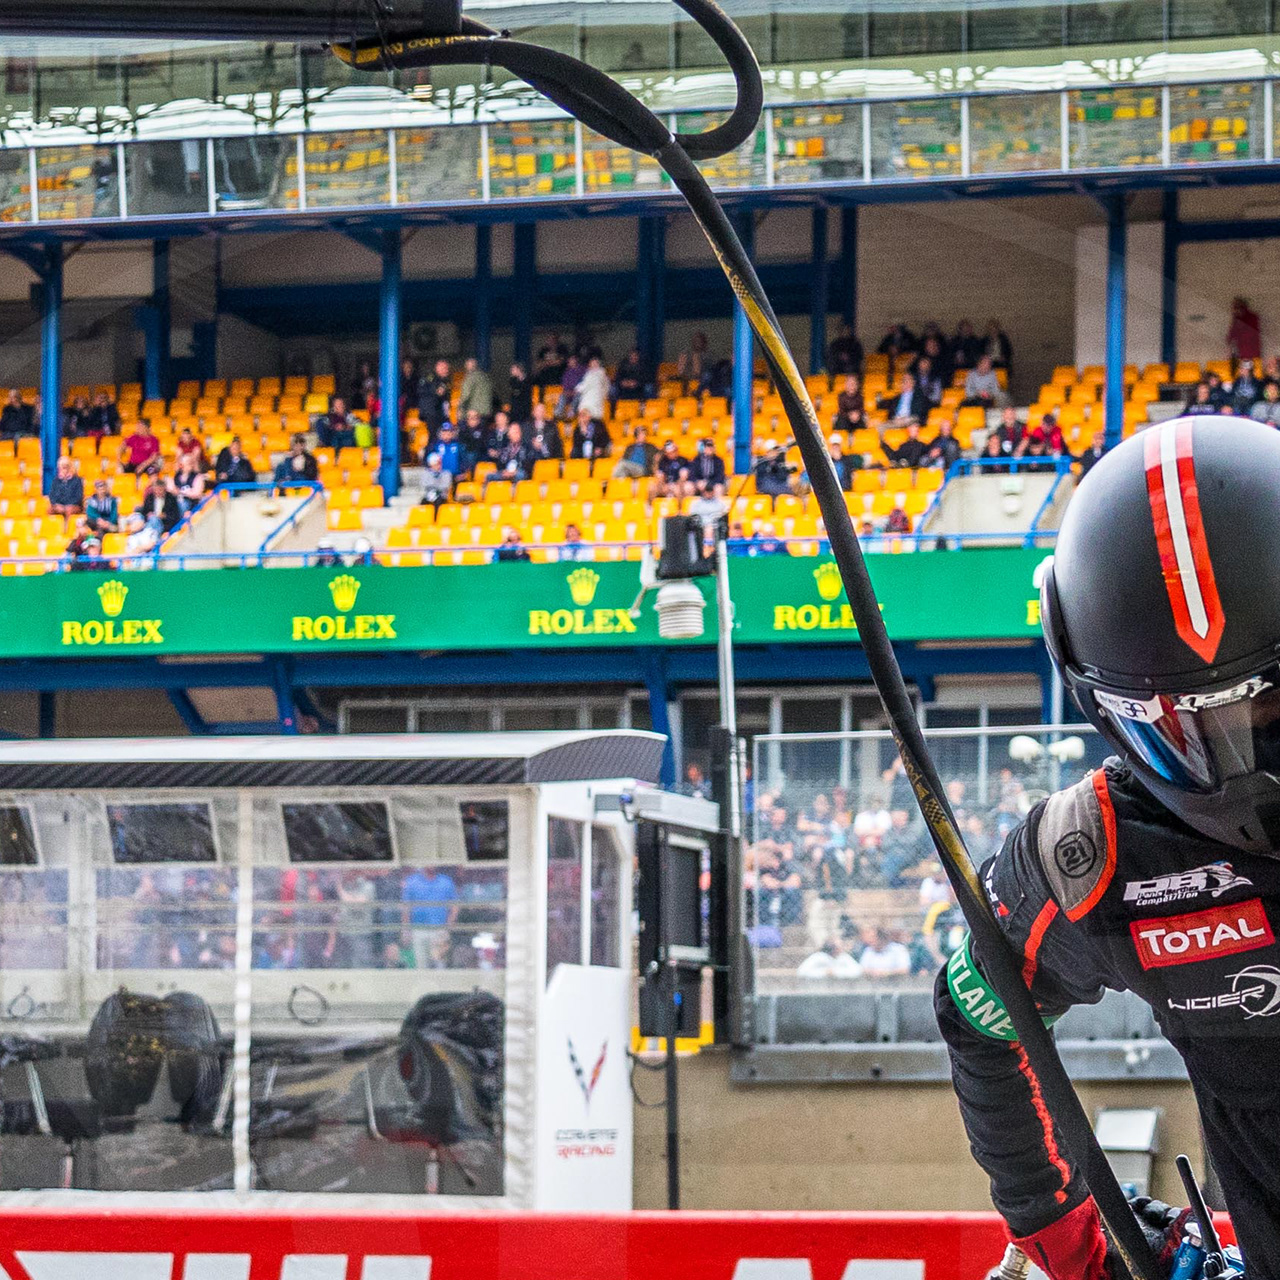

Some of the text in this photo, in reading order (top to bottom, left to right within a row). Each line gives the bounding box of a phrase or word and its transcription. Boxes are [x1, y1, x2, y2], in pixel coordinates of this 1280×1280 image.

[291, 614, 397, 641] ROLEX
[528, 608, 637, 635] ROLEX
[773, 603, 884, 631] ROLE
[62, 619, 163, 645] ROLEX
[1139, 918, 1265, 956] TOTAL
[951, 951, 1006, 1036] TLANE
